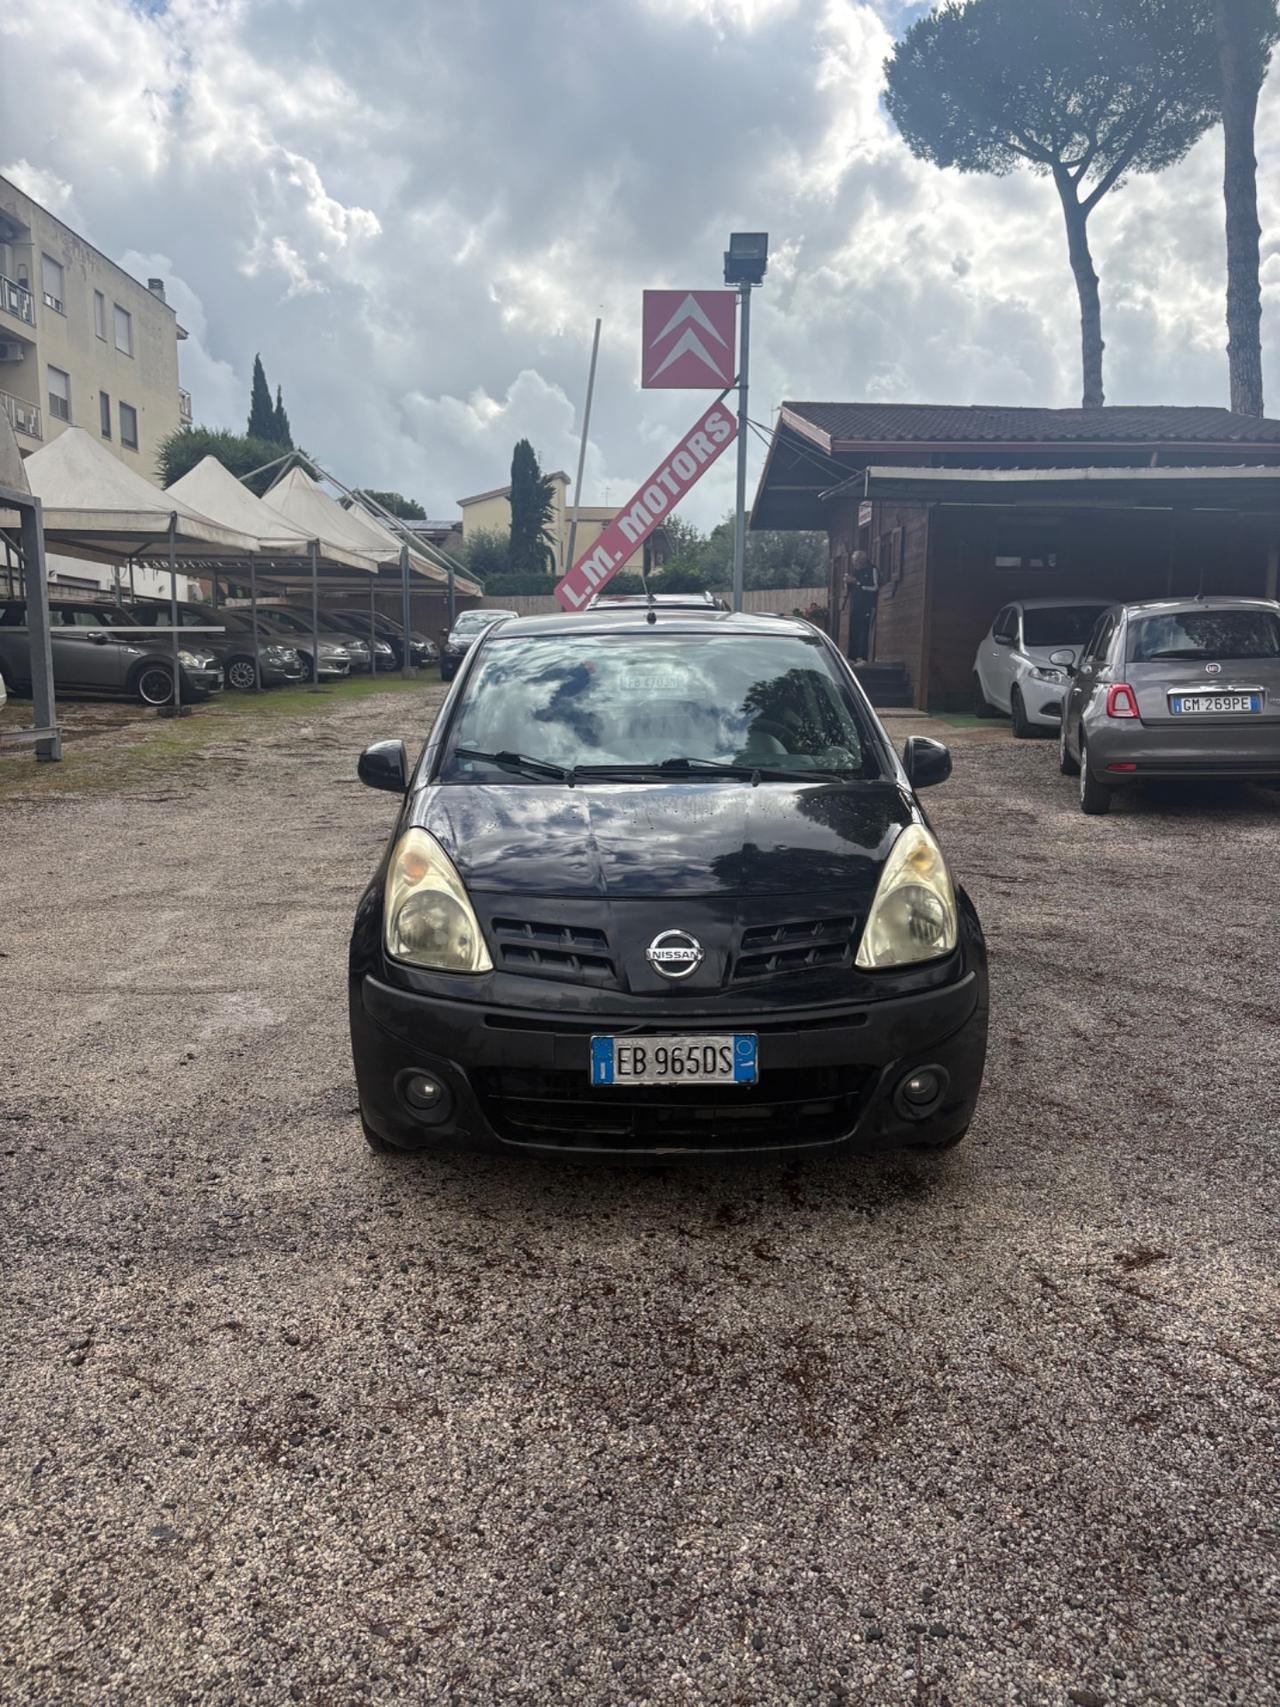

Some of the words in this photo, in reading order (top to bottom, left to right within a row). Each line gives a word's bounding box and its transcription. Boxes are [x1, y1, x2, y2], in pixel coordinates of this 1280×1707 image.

[562, 545, 623, 609] L.M.
[618, 412, 731, 543] MOTORS
[1183, 698, 1200, 711] GM
[1205, 697, 1249, 711] 269PE
[652, 951, 699, 959] NISSAN
[617, 1047, 646, 1075] EB
[655, 1046, 733, 1075] 965DS
